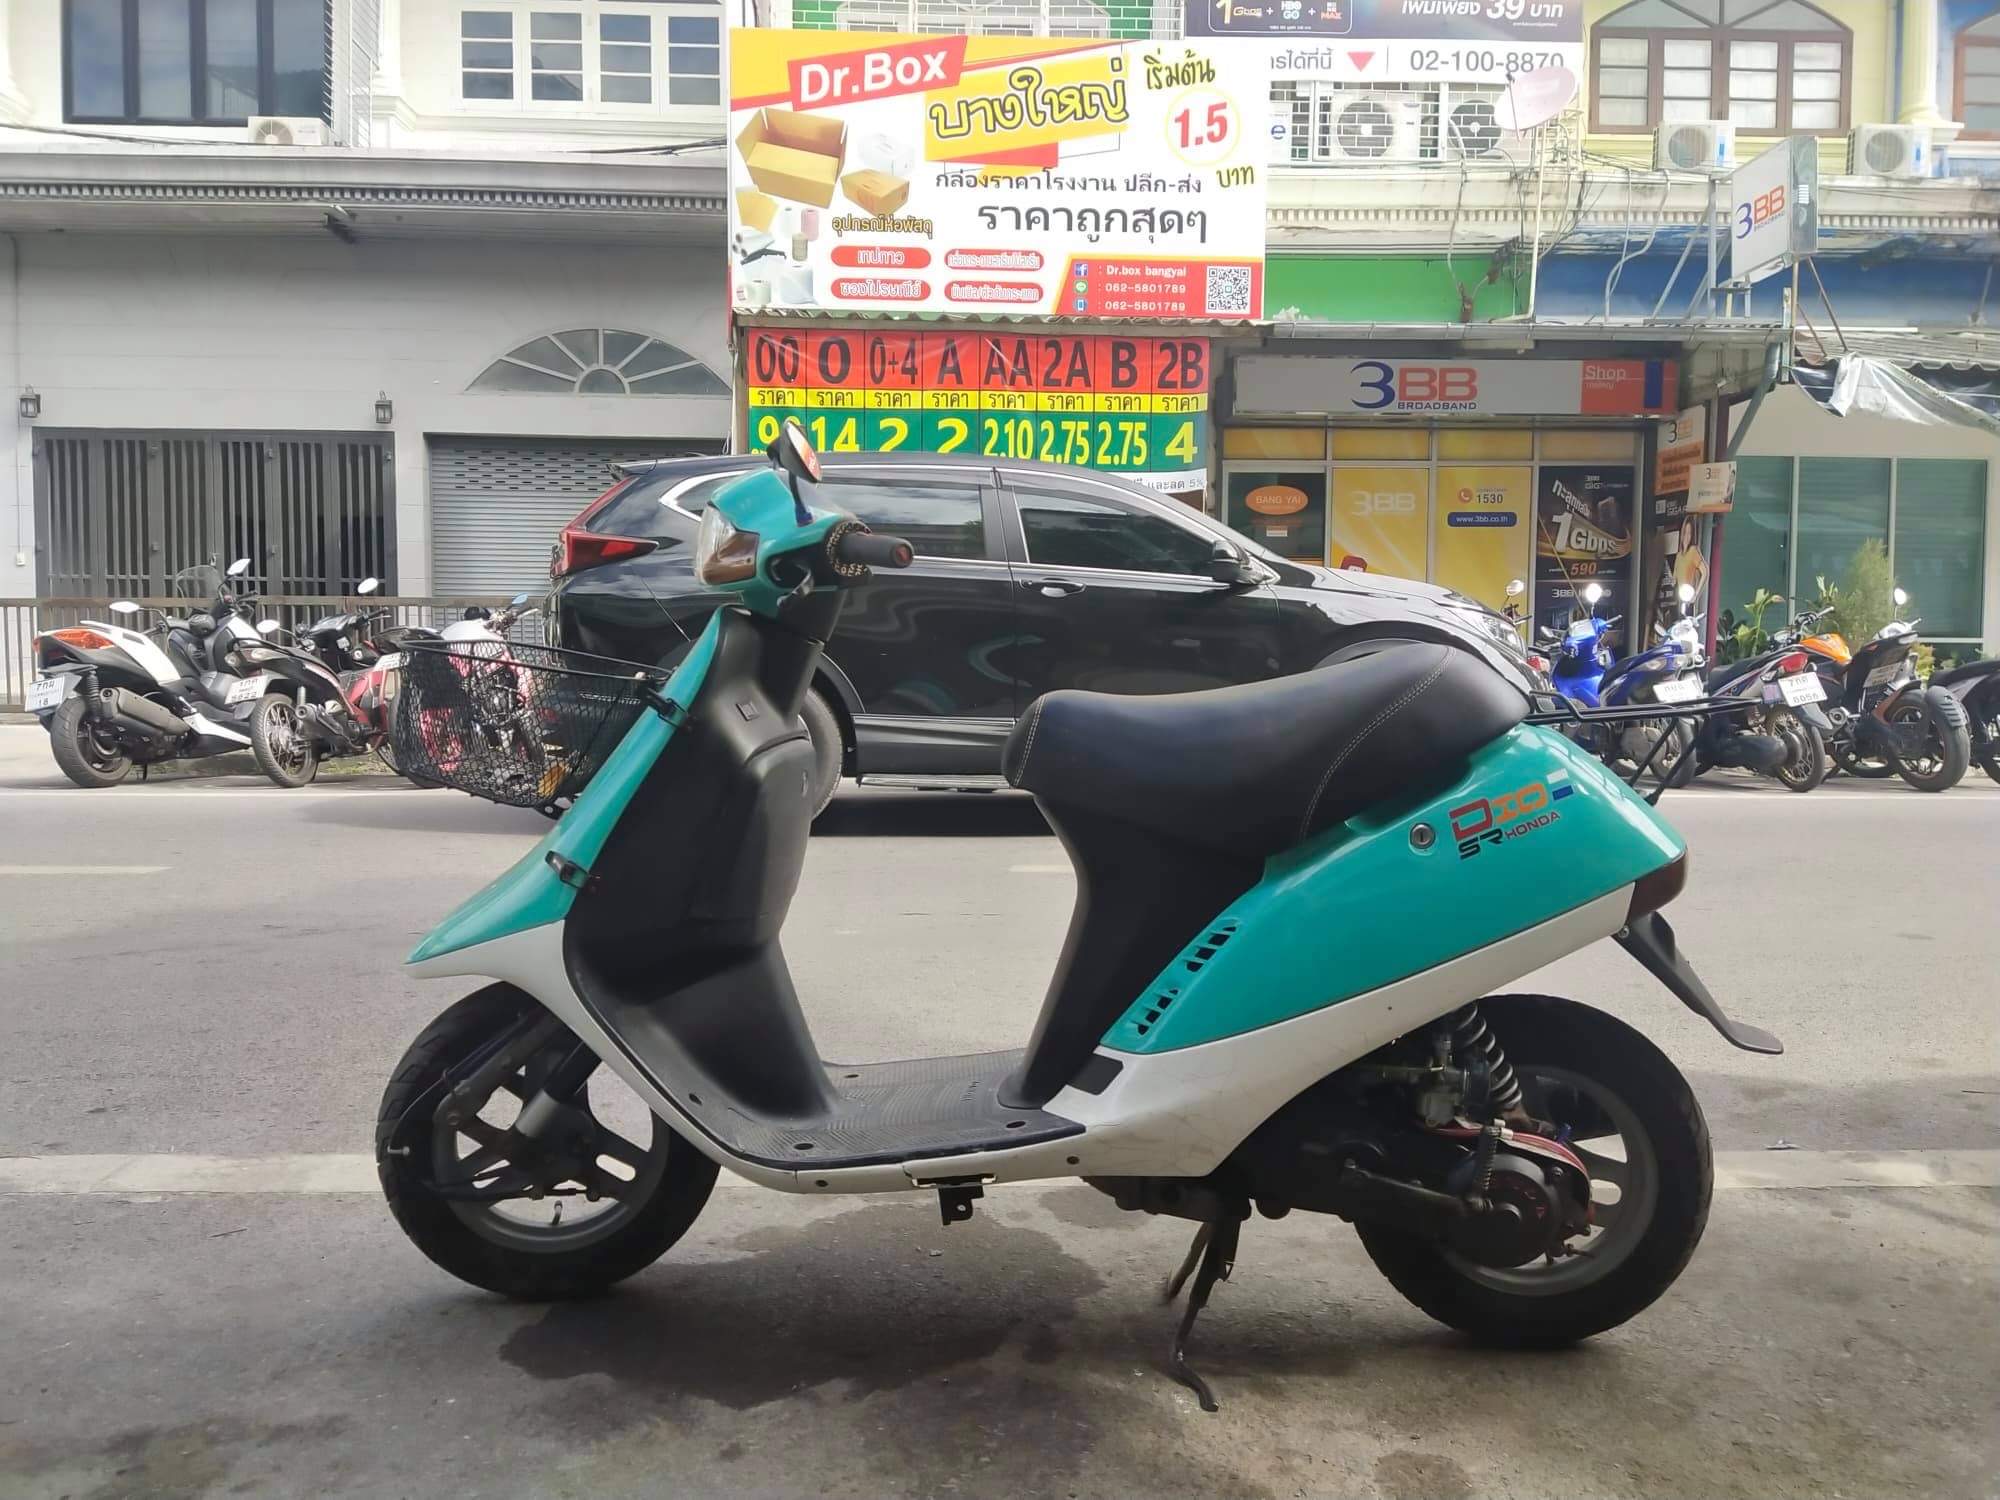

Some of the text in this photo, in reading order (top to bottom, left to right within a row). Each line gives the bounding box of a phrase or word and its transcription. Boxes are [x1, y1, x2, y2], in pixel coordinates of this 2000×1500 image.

[1486, 0, 1525, 20] 39
[1530, 4, 1563, 18] บาท
[800, 50, 948, 103] Dr.Box
[1144, 48, 1215, 90] เริ่มต้น
[1410, 50, 1564, 73] 02-100-8870
[930, 57, 1129, 138] บางใหญ่
[1174, 102, 1228, 148] 1.5
[935, 167, 1202, 194] กล่องราคาโรงงาน ปลีก-ส่ง
[1216, 165, 1255, 188] บาท
[978, 204, 1206, 243] ราคาถูกสุดๆ
[1736, 185, 1784, 239] 3BB
[937, 336, 964, 384] A
[983, 338, 1033, 387] AA
[1042, 339, 1092, 388] 2A
[1111, 341, 1138, 388] B
[1157, 342, 1204, 389] 2B
[1585, 365, 1626, 382] Shop
[758, 390, 795, 405] ราคา
[816, 391, 854, 406] ราคา
[874, 392, 911, 407] ราคา
[932, 392, 969, 408] ราคา
[989, 393, 1025, 409] ราคา
[1047, 394, 1084, 410] ราคา
[1104, 395, 1141, 411] ราคา
[1350, 361, 1478, 409] 3BB
[1162, 396, 1199, 411] ราคา
[1397, 402, 1477, 410] BROADBAND
[879, 417, 909, 453] 2
[937, 418, 968, 454] 2
[983, 418, 1034, 460] 2.10
[1040, 420, 1090, 465] 2.75
[1096, 421, 1147, 466] 2.75
[1165, 421, 1198, 464] 4
[1255, 495, 1301, 504] BANG YAI
[1351, 491, 1416, 515] 3BB
[1477, 493, 1503, 504] 1530
[1552, 511, 1573, 552] 1
[1570, 562, 1597, 575] 590
[1458, 811, 1560, 860] SR HONDA
